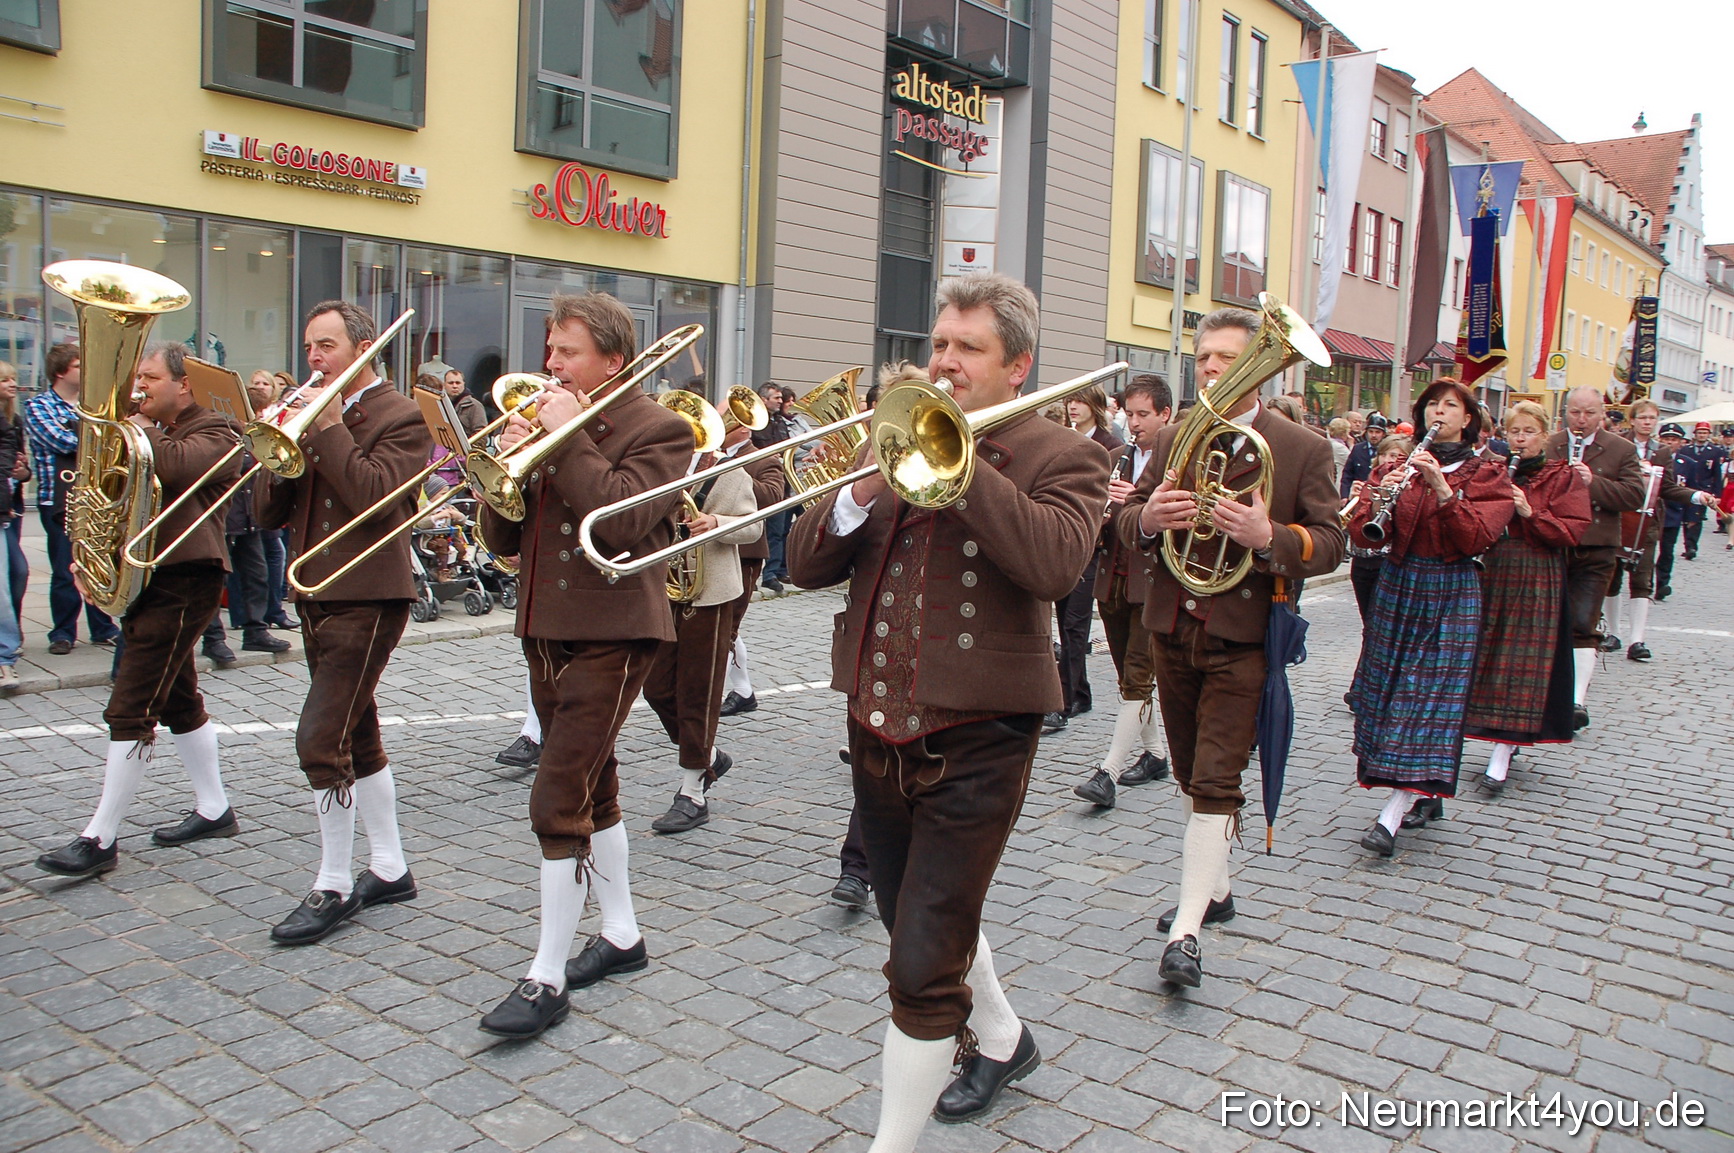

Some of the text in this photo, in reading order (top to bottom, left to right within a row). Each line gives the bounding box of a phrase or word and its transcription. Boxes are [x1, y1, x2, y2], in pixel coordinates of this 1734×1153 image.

[896, 62, 990, 125] altstadt
[243, 136, 395, 183] IL GOLOSONE
[895, 107, 989, 162] passage
[200, 160, 421, 205] PASTERIA ESPRESSOBAR FEINKOST
[530, 161, 670, 239] s.Oliver
